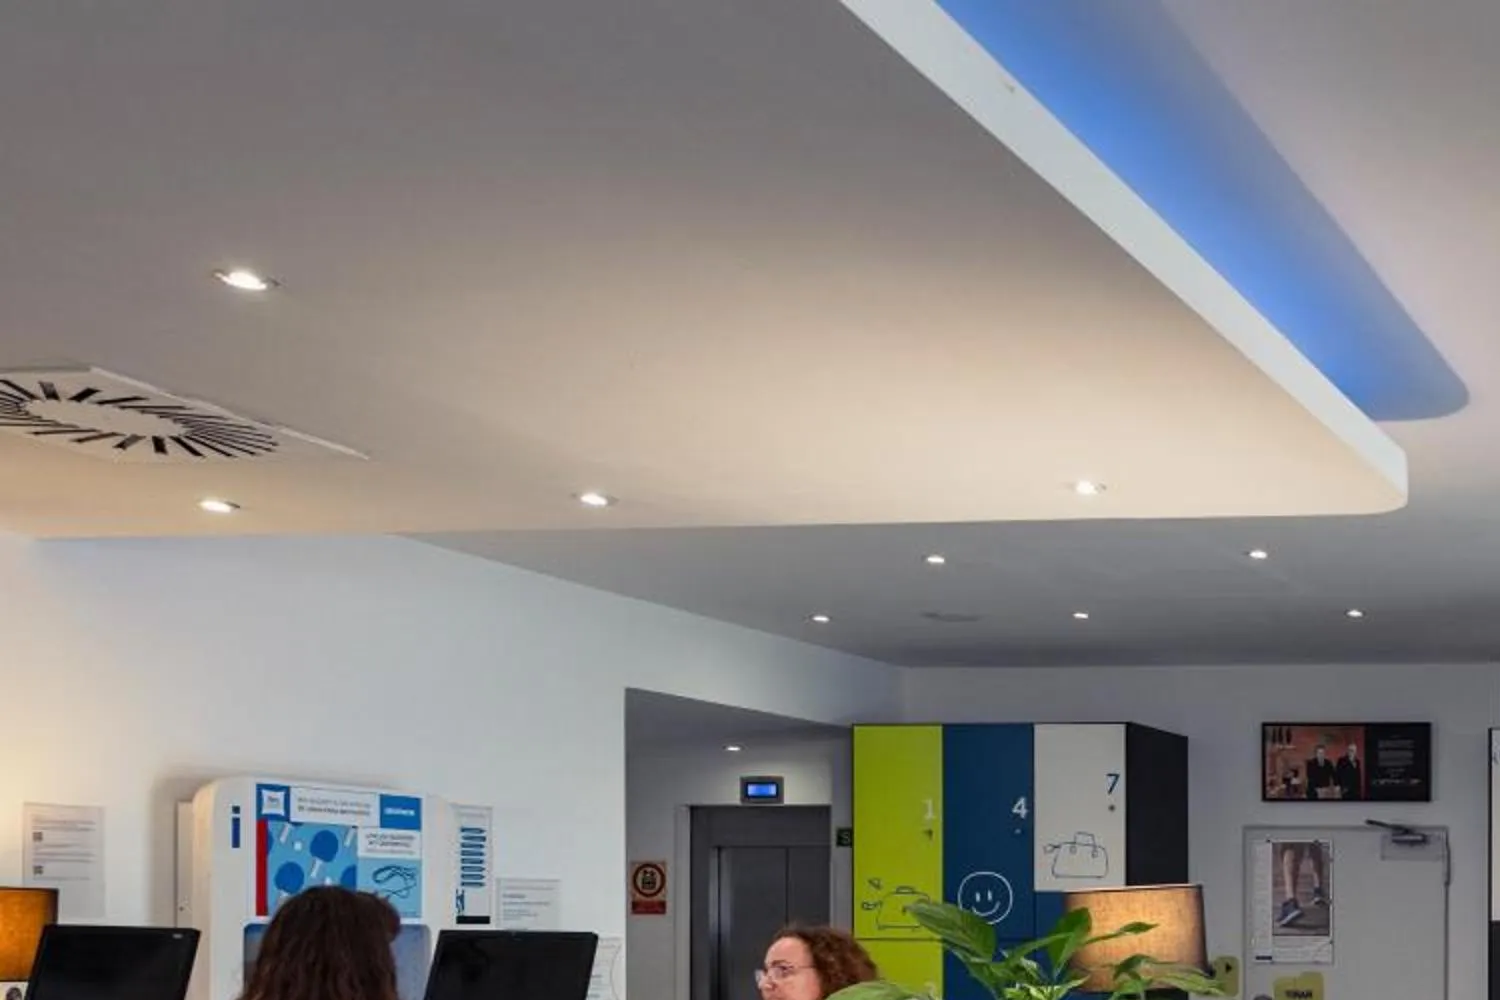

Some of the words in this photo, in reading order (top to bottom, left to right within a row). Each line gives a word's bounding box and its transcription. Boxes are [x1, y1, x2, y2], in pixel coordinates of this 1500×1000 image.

[1106, 773, 1120, 795] 7
[924, 800, 936, 820] 1
[1012, 798, 1028, 818] 4
